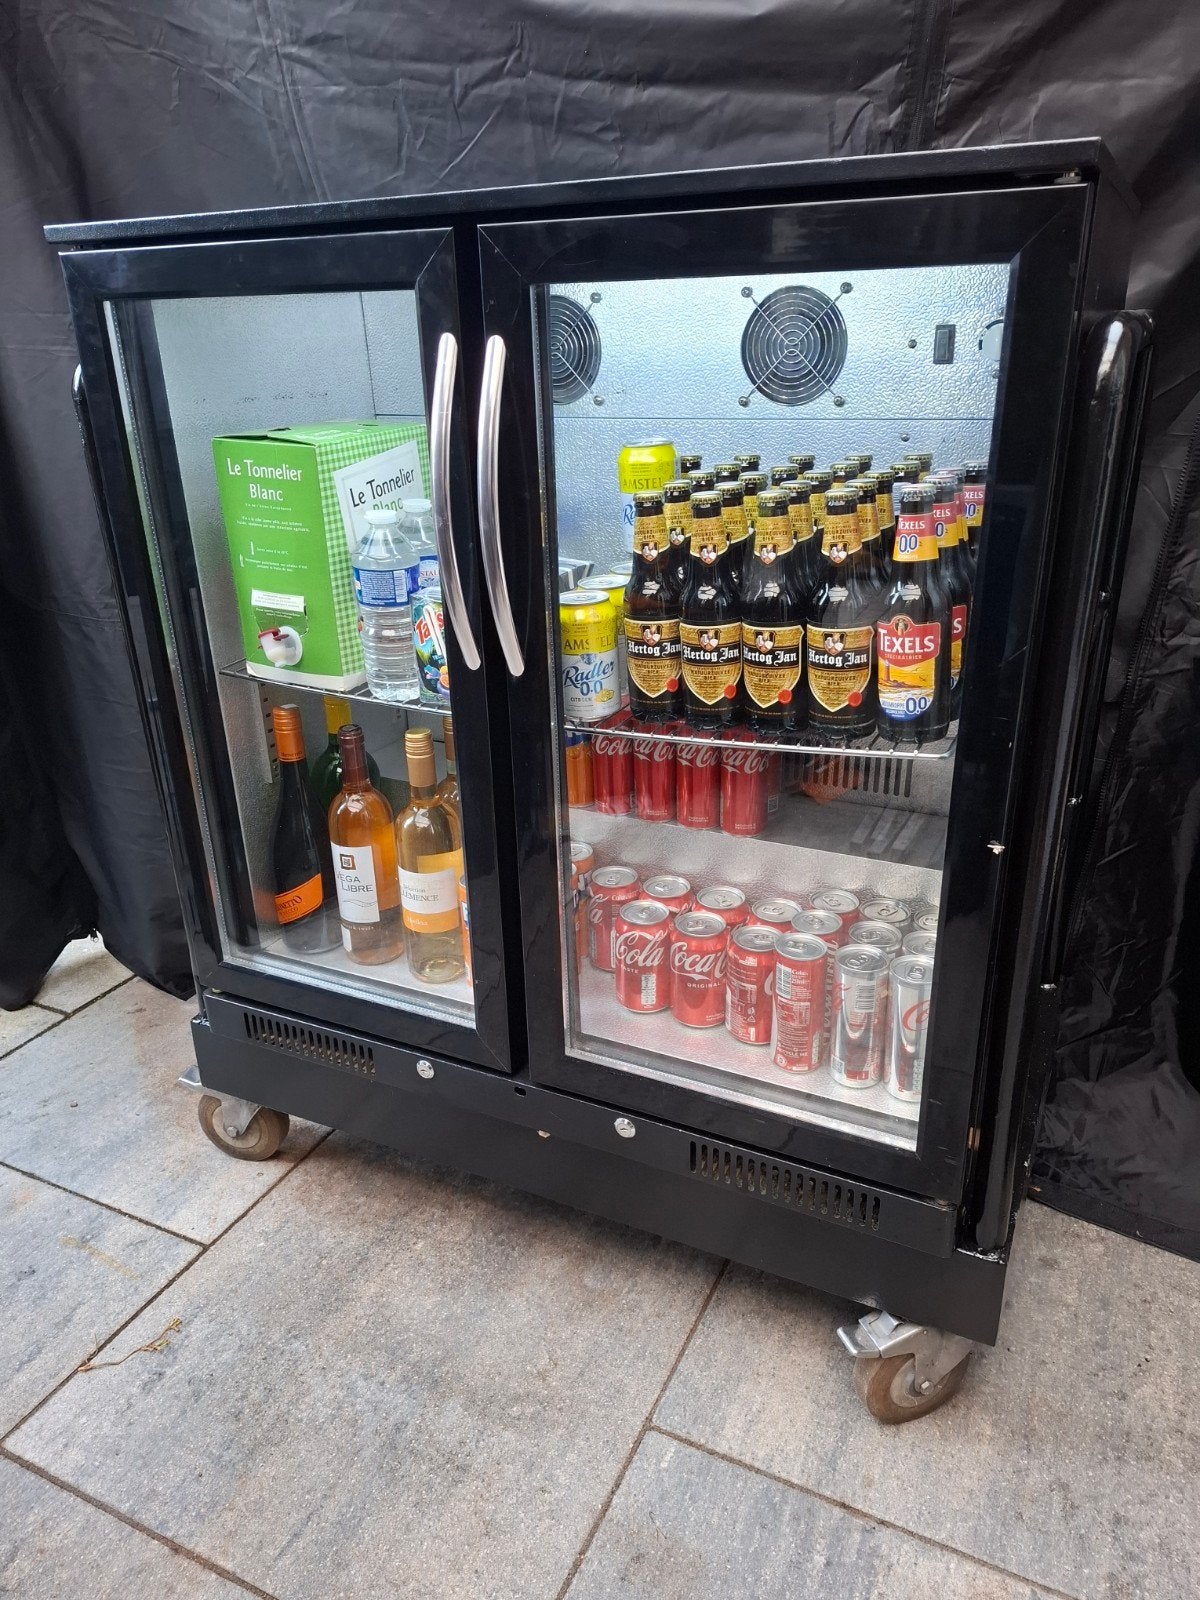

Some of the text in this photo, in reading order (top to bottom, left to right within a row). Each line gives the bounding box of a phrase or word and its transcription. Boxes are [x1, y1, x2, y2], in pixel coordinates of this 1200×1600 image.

[226, 457, 303, 482] Le Tonnelier
[249, 483, 284, 502] Blanc
[349, 468, 415, 508] Le Tonnelier
[627, 640, 682, 658] Hertog Jan
[878, 628, 935, 654] TEXELS
[683, 645, 740, 663] Hertog Jan
[743, 645, 797, 667] Hertog Jan
[808, 647, 868, 669] Hertog Jan
[562, 661, 615, 689] Radler
[341, 882, 374, 894] LIBRE
[615, 929, 668, 968] Cola
